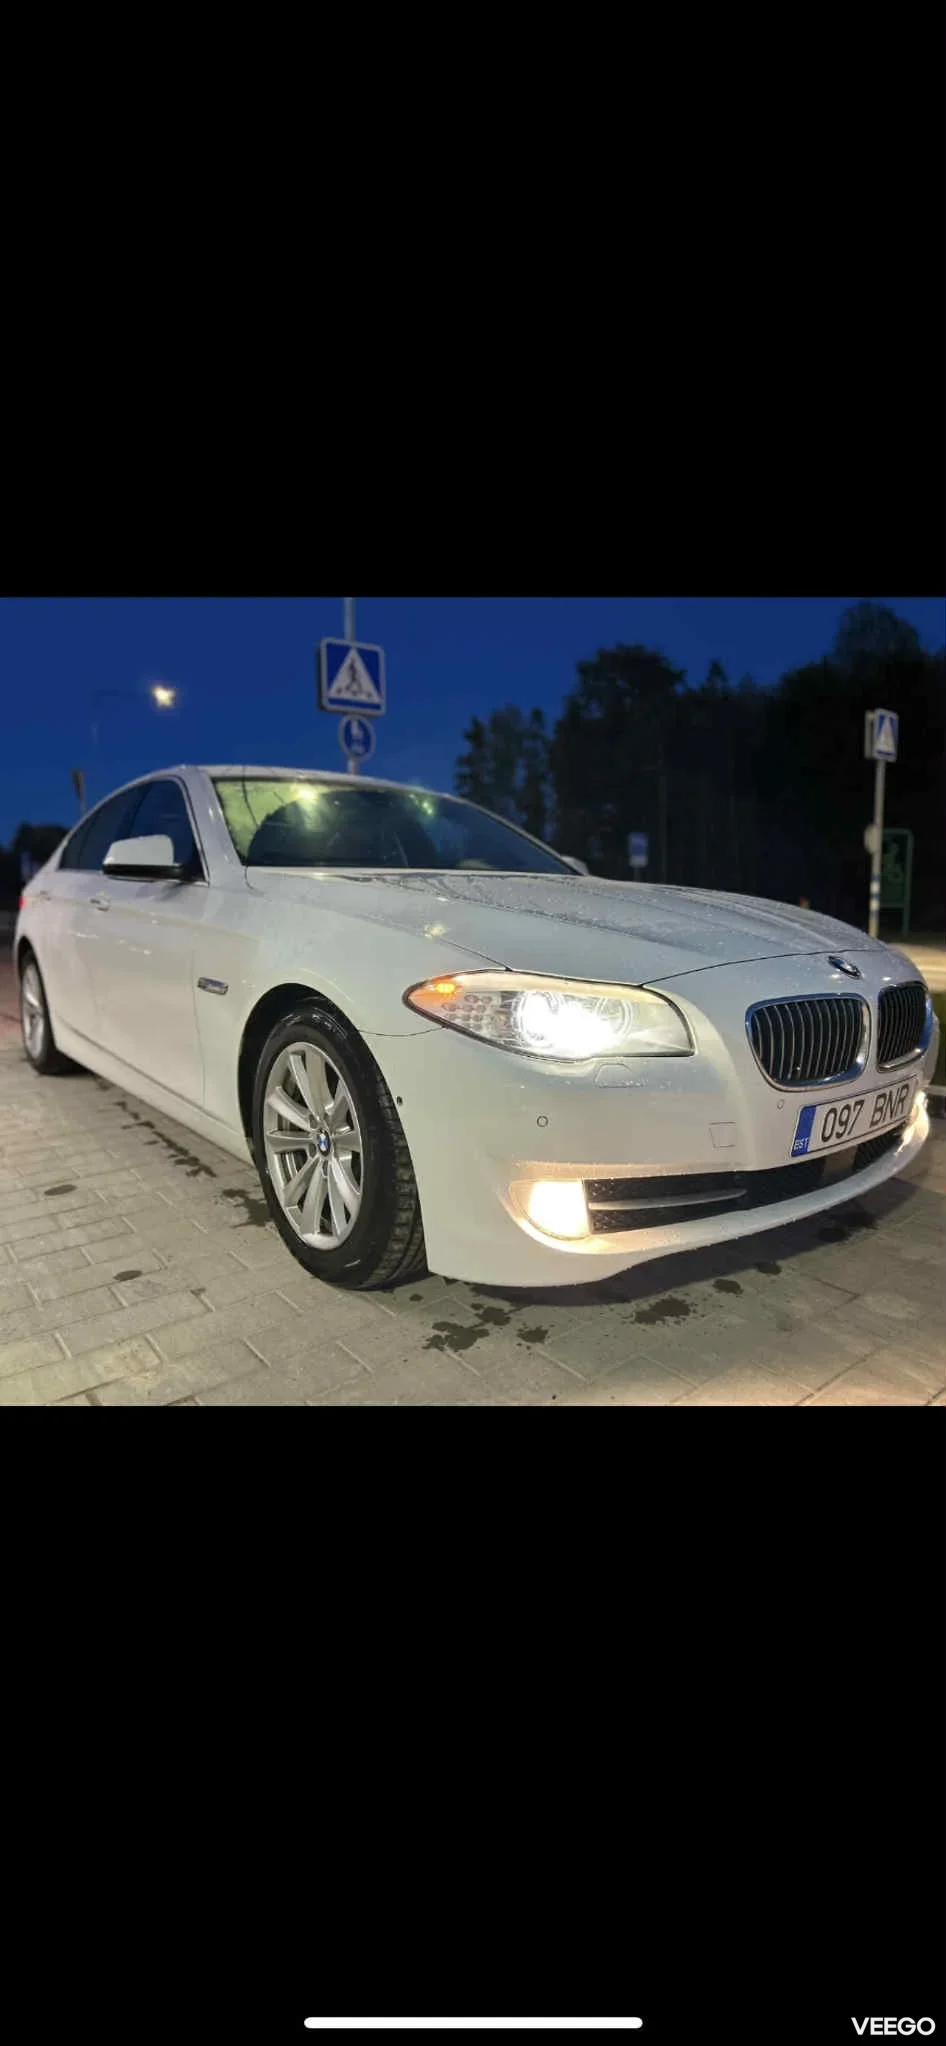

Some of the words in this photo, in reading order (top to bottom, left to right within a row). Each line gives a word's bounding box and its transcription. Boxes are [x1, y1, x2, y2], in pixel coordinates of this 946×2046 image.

[821, 1099, 865, 1143] 097
[869, 1083, 910, 1129] BNR
[794, 1137, 809, 1151] EST
